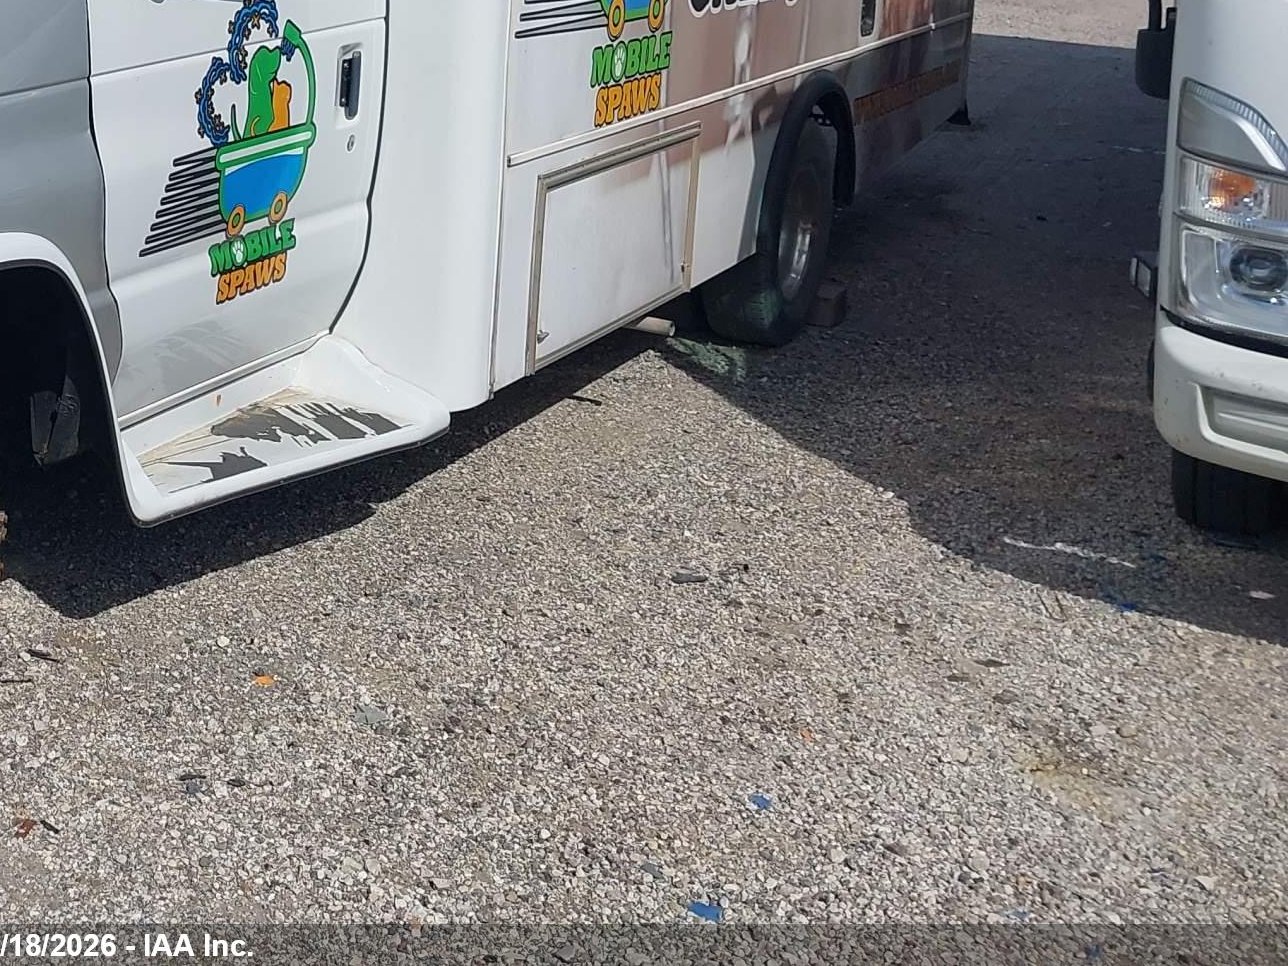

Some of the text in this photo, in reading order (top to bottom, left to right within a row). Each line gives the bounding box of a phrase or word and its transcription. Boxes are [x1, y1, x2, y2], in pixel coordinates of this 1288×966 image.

[590, 30, 673, 88] MOBILE
[594, 71, 661, 127] SPAWS
[208, 218, 297, 277] MOBILE
[215, 253, 287, 305] SPAWS
